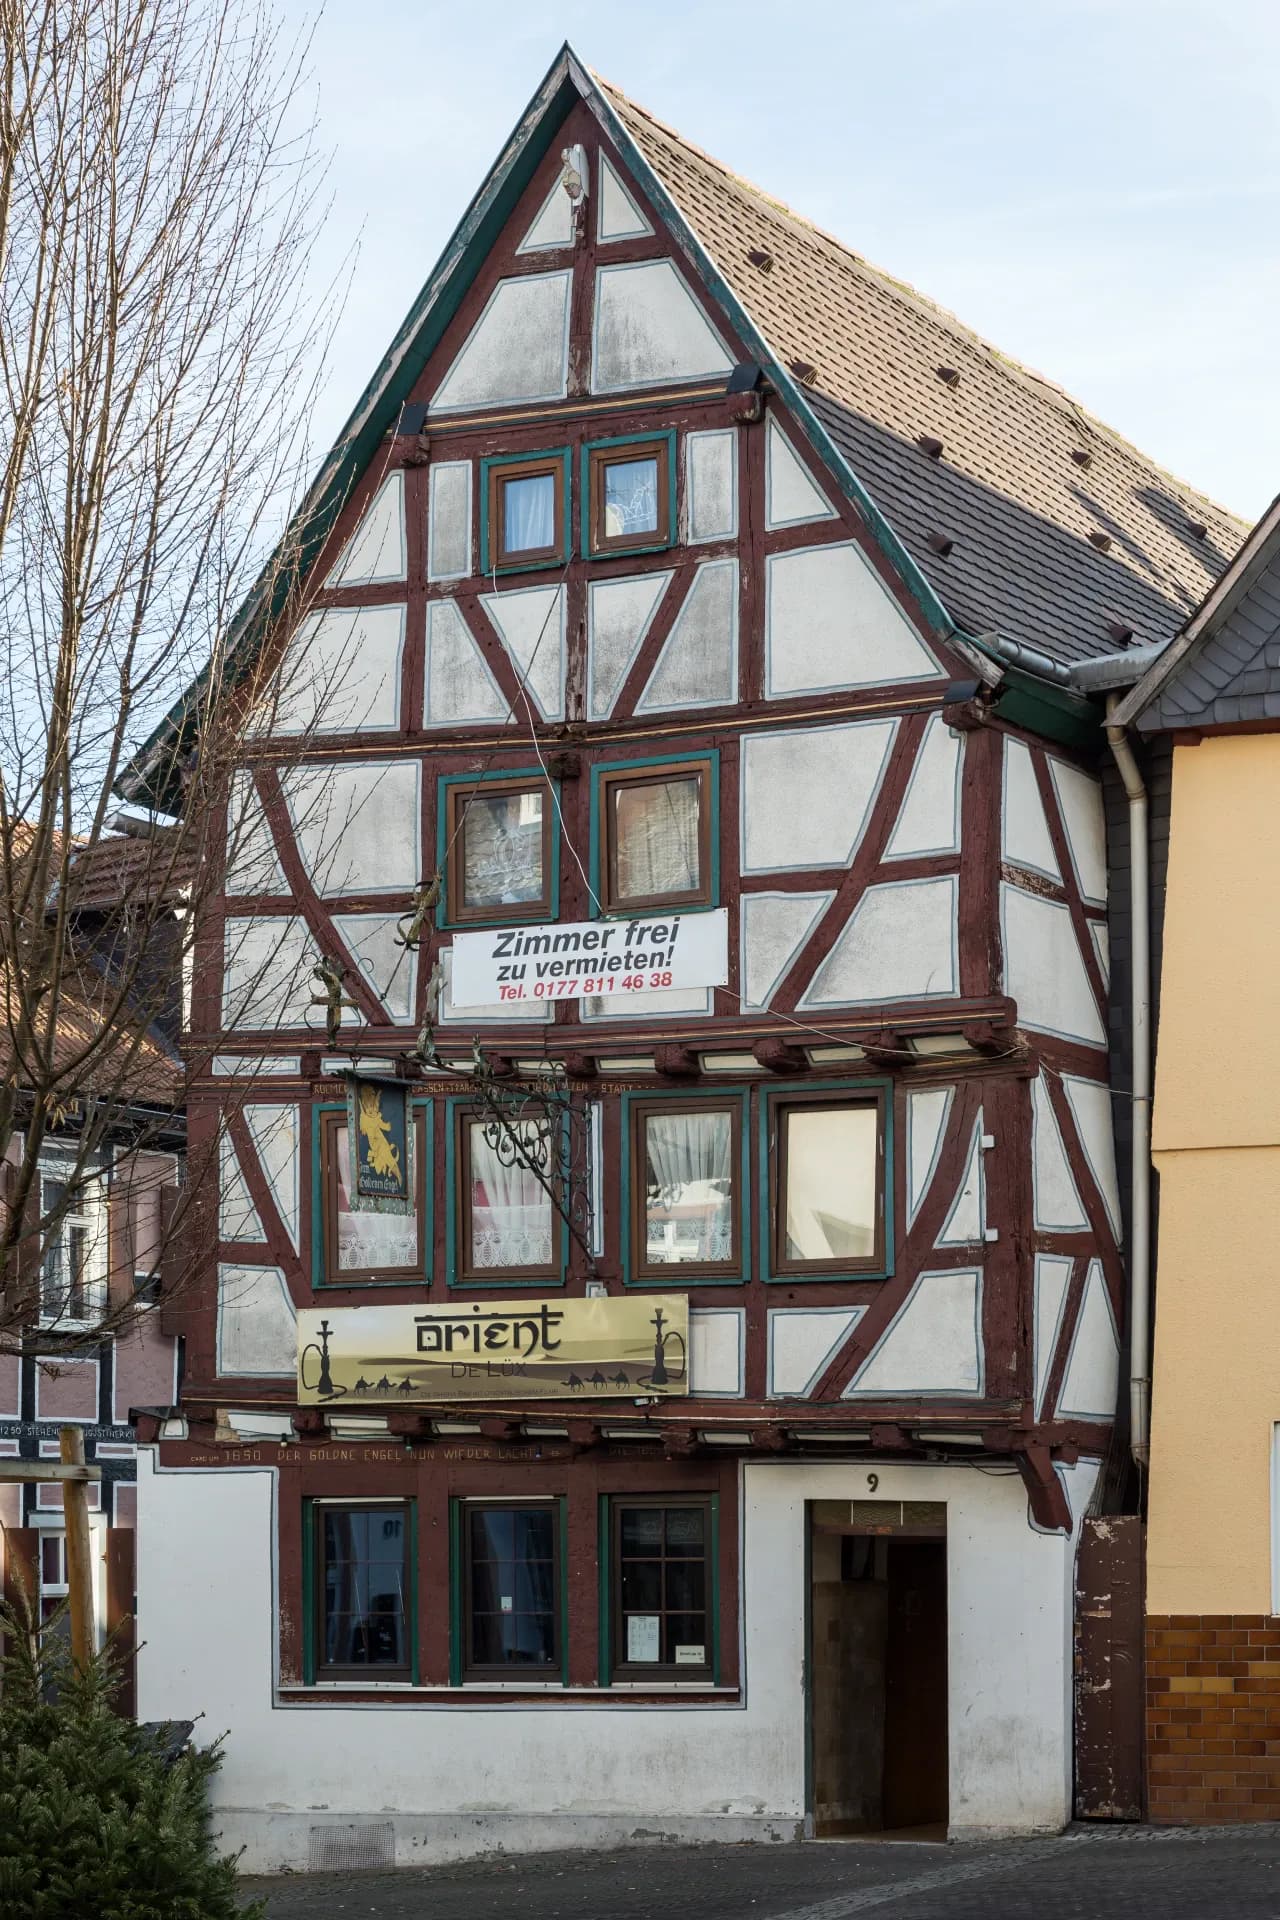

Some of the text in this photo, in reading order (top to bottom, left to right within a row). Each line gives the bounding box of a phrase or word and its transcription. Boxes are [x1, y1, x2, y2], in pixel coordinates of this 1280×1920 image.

[492, 917, 680, 958] Zimmer frei
[497, 946, 674, 981] zu vermieten!
[499, 972, 672, 1000] Tel. 0177 811 46 38
[277, 1449, 301, 1461] DER
[364, 1448, 402, 1461] ENGEL
[866, 1472, 879, 1493] 9
